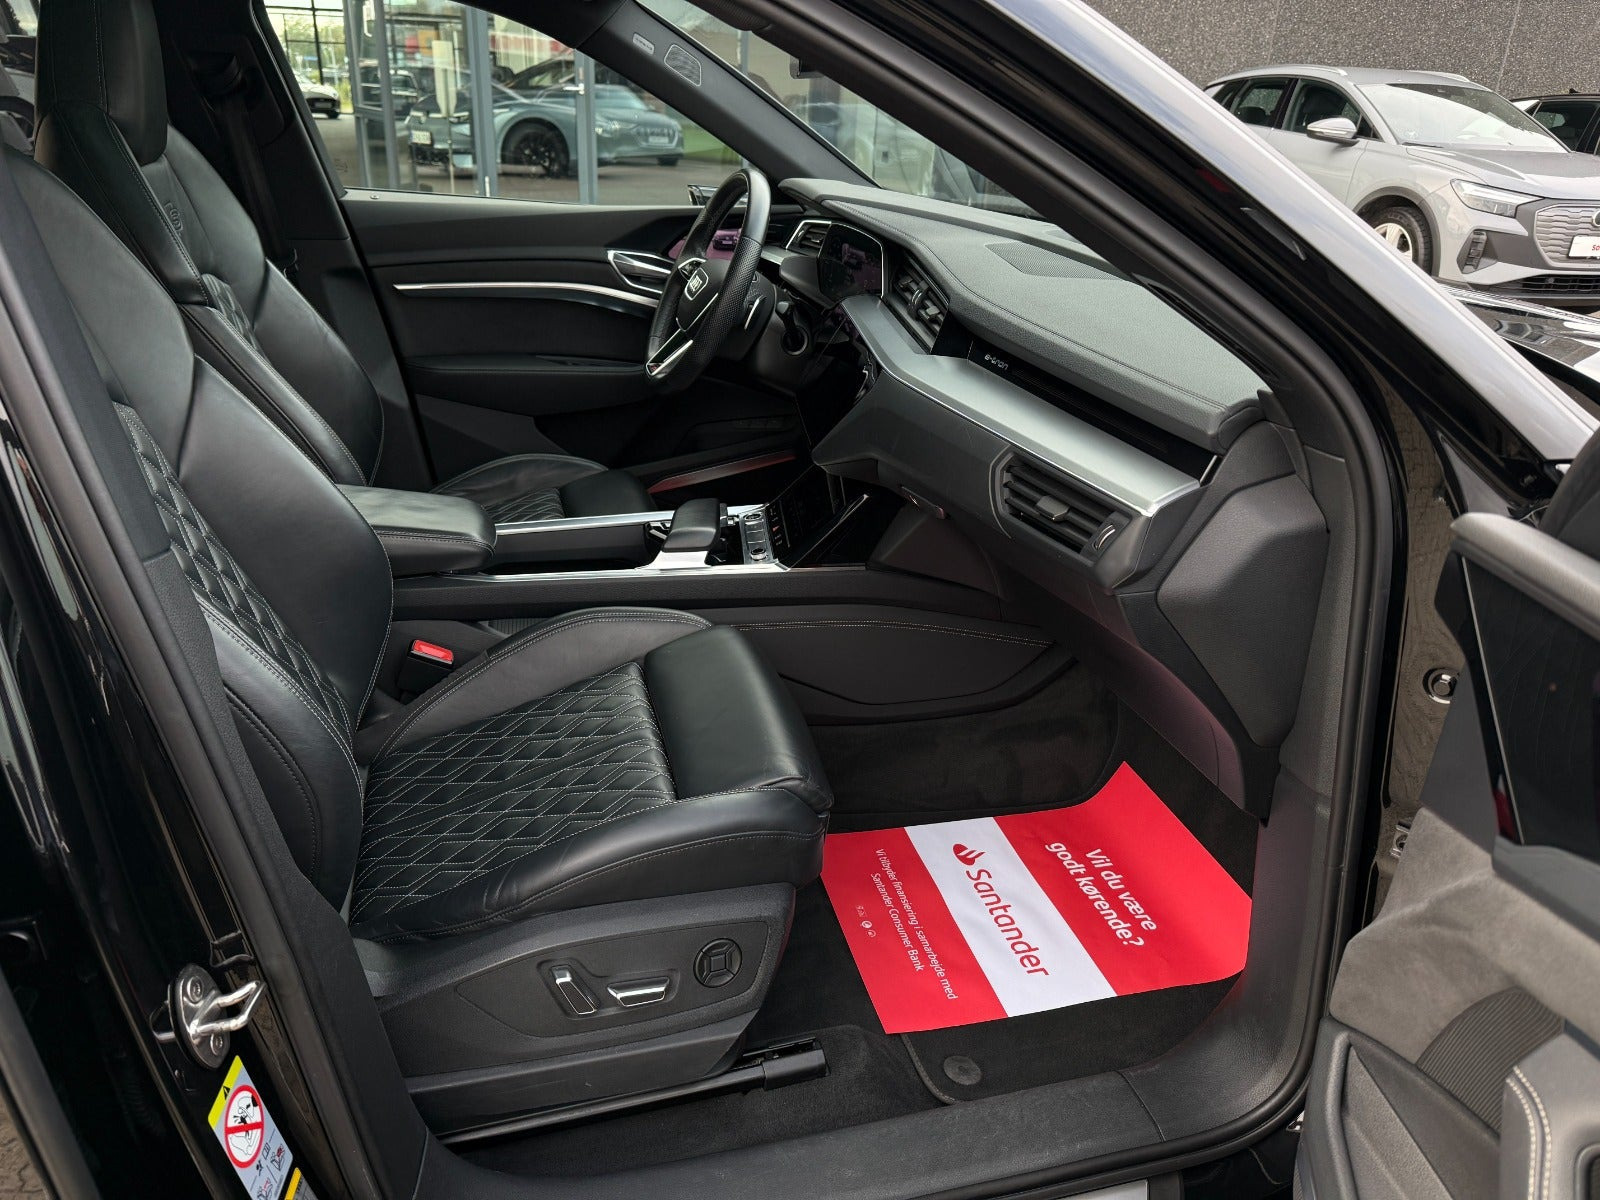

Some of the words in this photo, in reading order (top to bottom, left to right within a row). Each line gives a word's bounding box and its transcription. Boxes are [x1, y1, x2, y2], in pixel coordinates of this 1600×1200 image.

[984, 353, 1009, 371] e-tron
[875, 848, 885, 857] Vi
[879, 856, 898, 881] tilbyder
[891, 881, 919, 926] finansiering
[1044, 842, 1087, 876] godt
[1074, 876, 1145, 946] kørende?
[1085, 848, 1114, 868] Vil
[1100, 870, 1125, 890] du
[1118, 891, 1157, 930] være
[870, 872, 895, 908] Santander
[888, 908, 914, 949] Consumer
[907, 949, 925, 972] Bank
[965, 868, 1050, 976] Santander
[915, 929, 946, 978] samarbejde
[940, 978, 959, 1000] med
